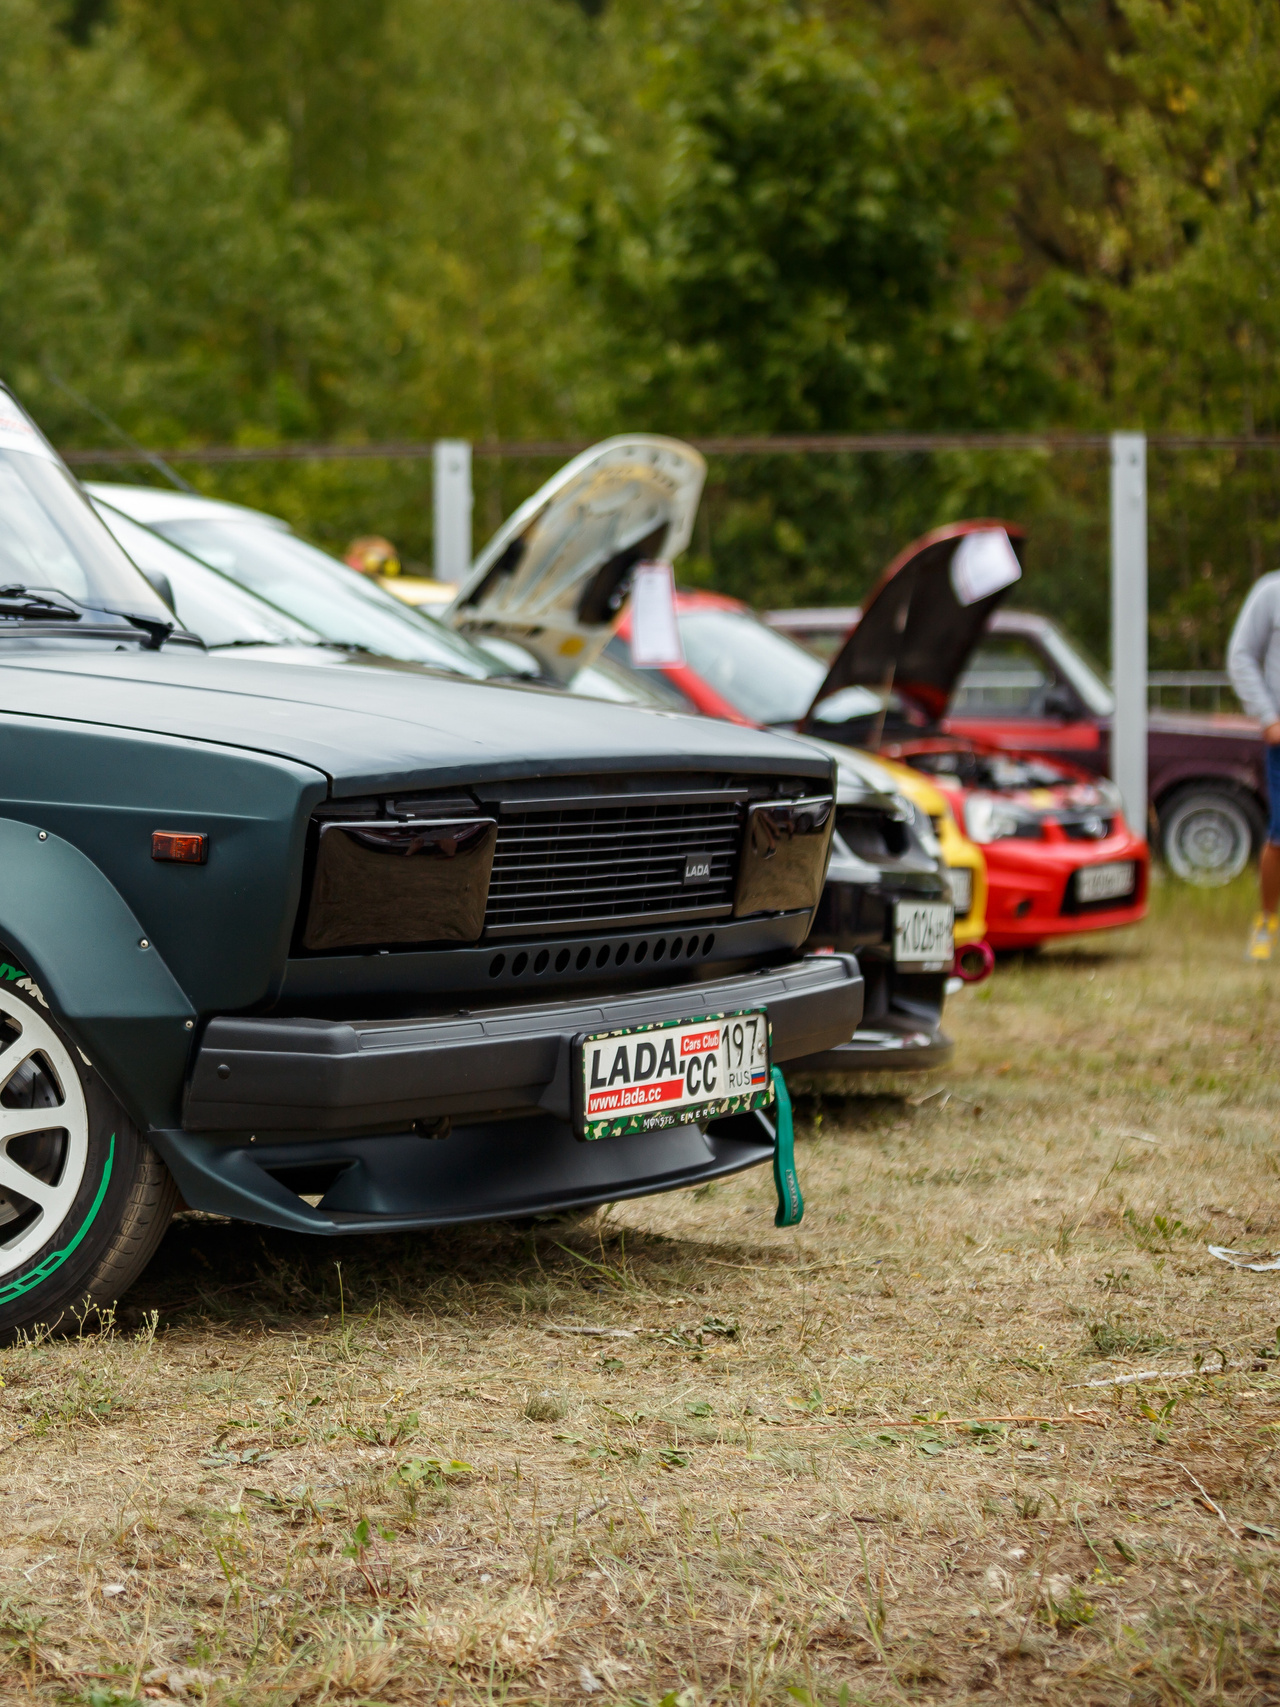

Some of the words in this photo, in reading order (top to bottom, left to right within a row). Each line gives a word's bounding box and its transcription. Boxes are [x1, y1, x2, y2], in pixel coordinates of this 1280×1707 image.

[685, 863, 710, 877] LADA
[683, 1037, 701, 1052] Cars
[702, 1033, 719, 1049] Club
[722, 1018, 759, 1071] 197
[729, 1070, 750, 1088] RUS
[590, 1086, 661, 1112] www.lada.cc
